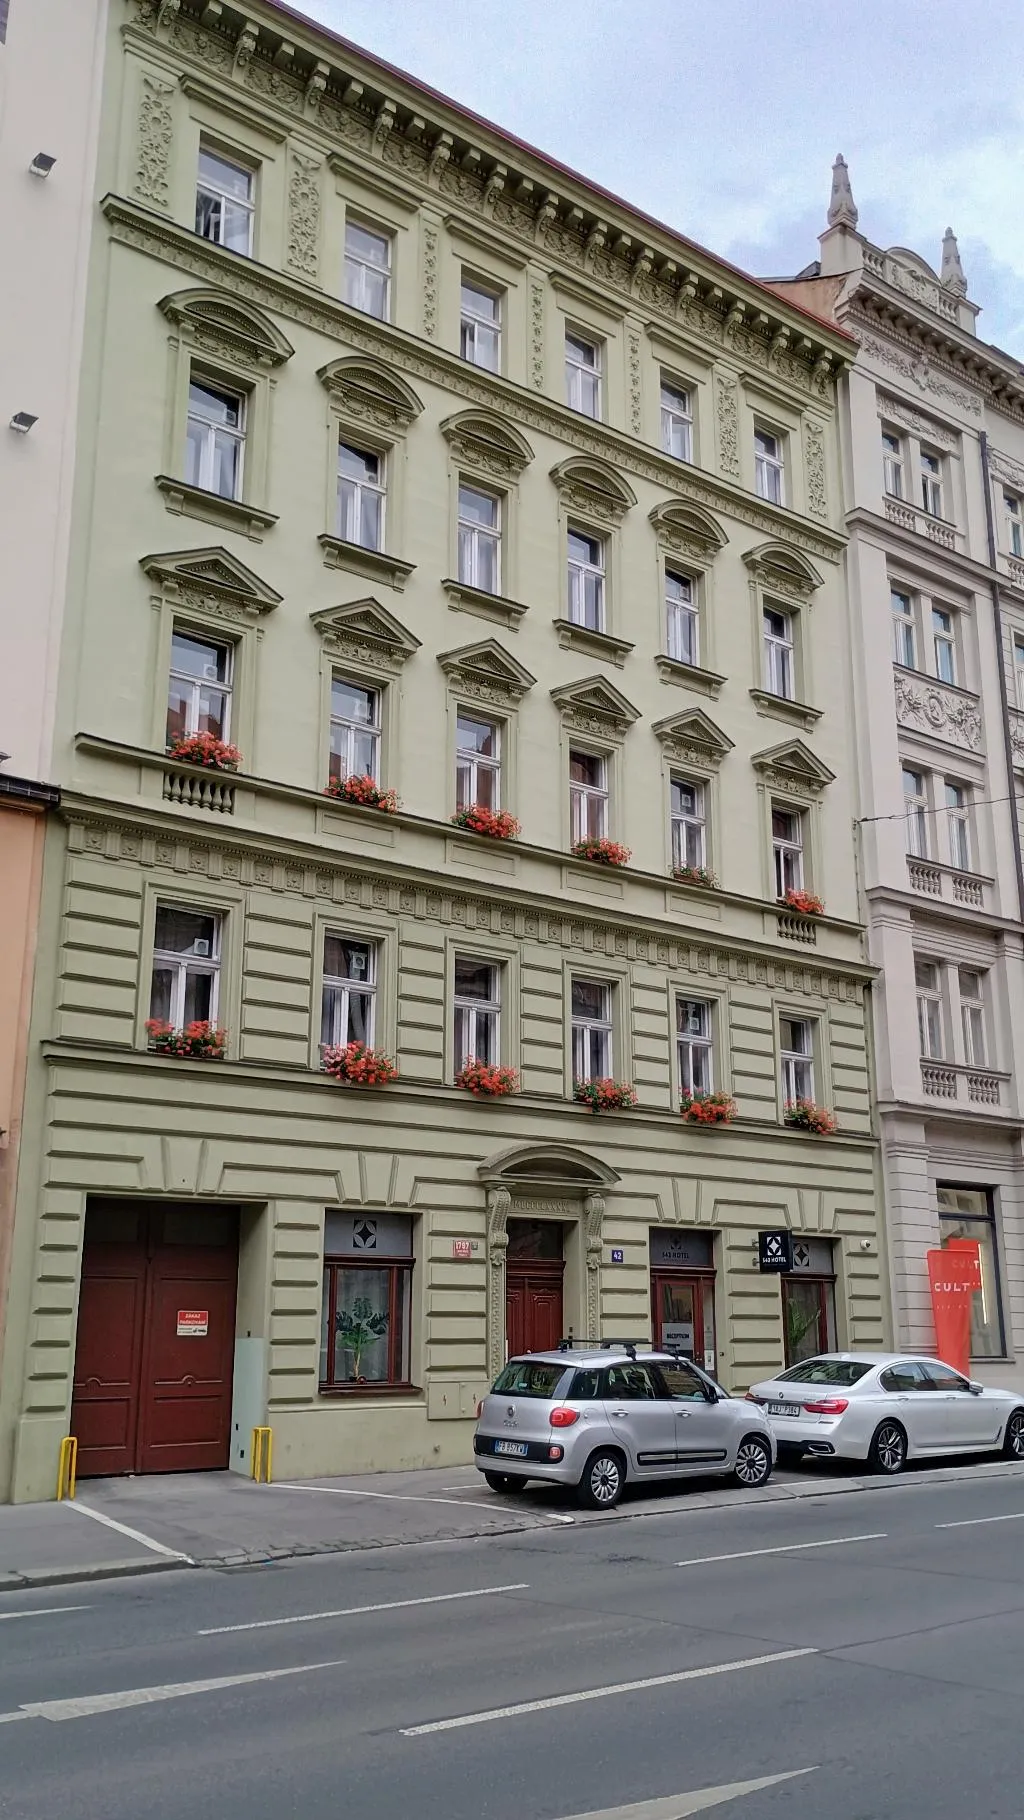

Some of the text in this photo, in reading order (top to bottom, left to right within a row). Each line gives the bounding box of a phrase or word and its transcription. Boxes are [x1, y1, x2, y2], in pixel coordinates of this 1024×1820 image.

[455, 1241, 470, 1250] 1797
[613, 1251, 622, 1260] 42
[934, 1282, 971, 1292] CULT
